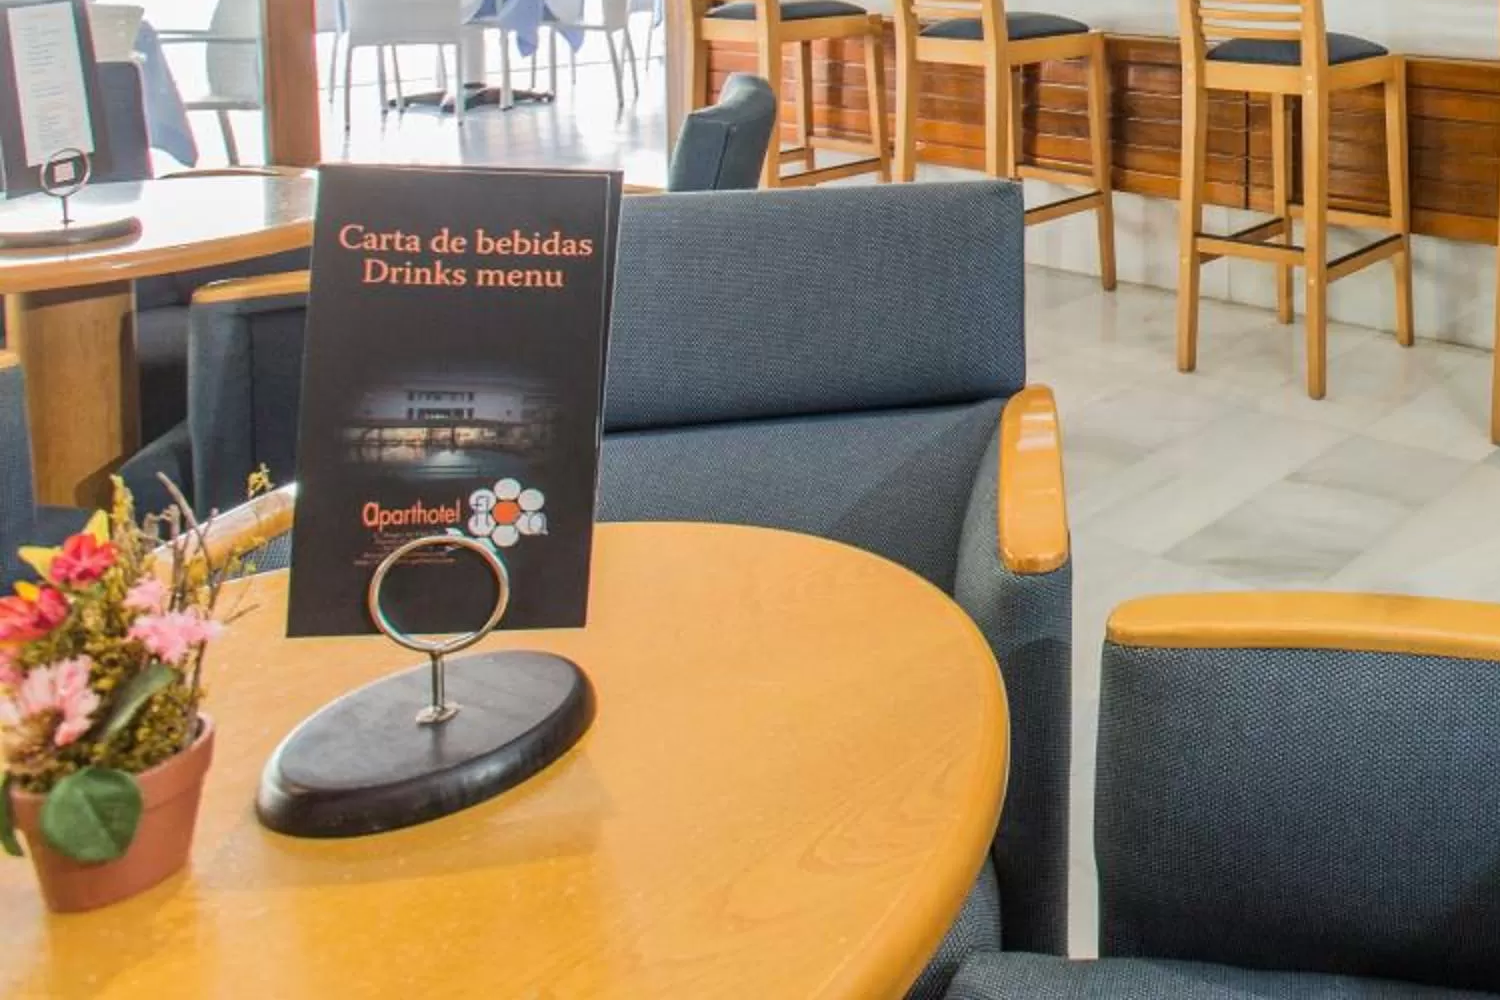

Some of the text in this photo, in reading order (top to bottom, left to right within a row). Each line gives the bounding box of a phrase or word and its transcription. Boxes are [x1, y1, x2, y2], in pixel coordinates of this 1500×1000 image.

[339, 224, 593, 257] Carta de bebidas
[362, 258, 563, 288] Drinks menu
